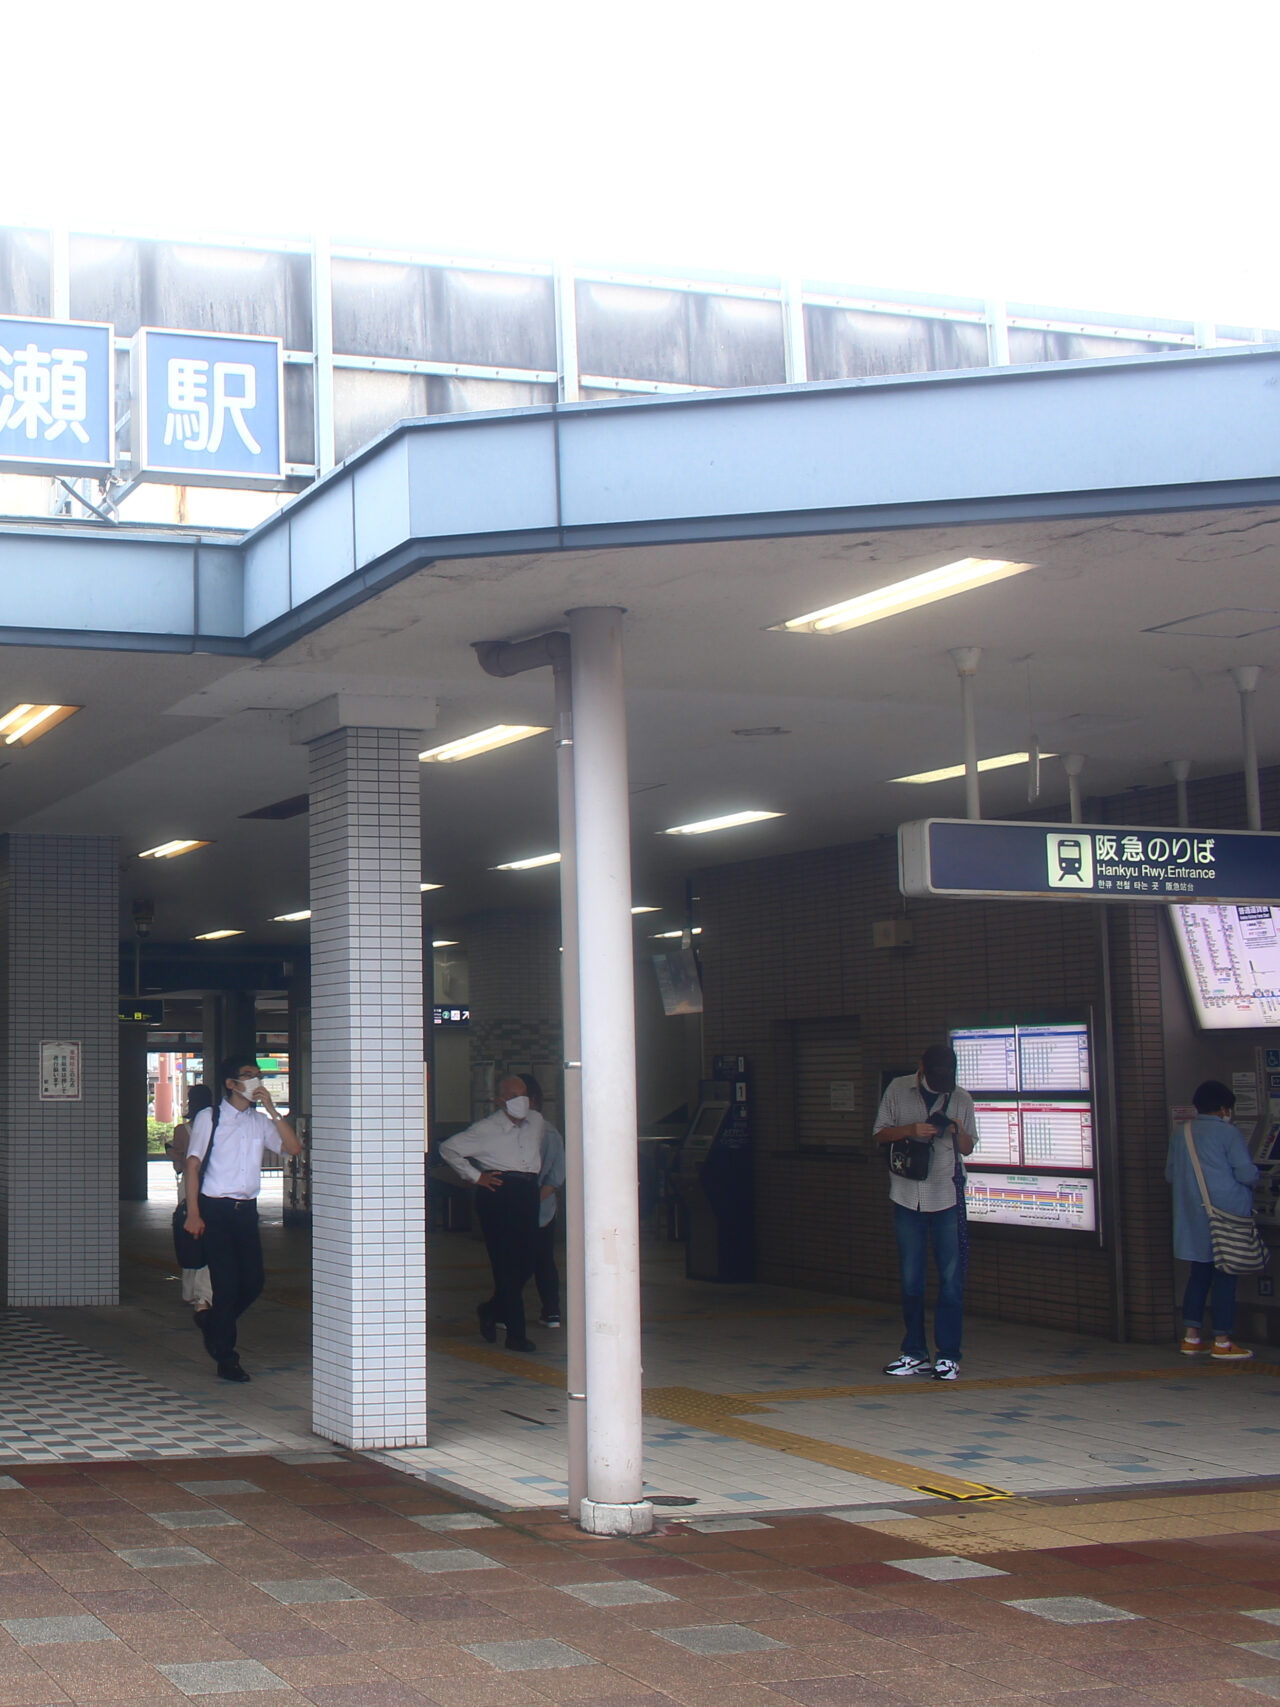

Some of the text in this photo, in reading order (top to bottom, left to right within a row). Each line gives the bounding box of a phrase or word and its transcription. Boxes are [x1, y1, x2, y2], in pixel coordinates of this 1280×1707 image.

[1095, 834, 1216, 864] 阪急のりば
[1096, 863, 1139, 879] Hankyu
[1098, 880, 1113, 890] 한큐
